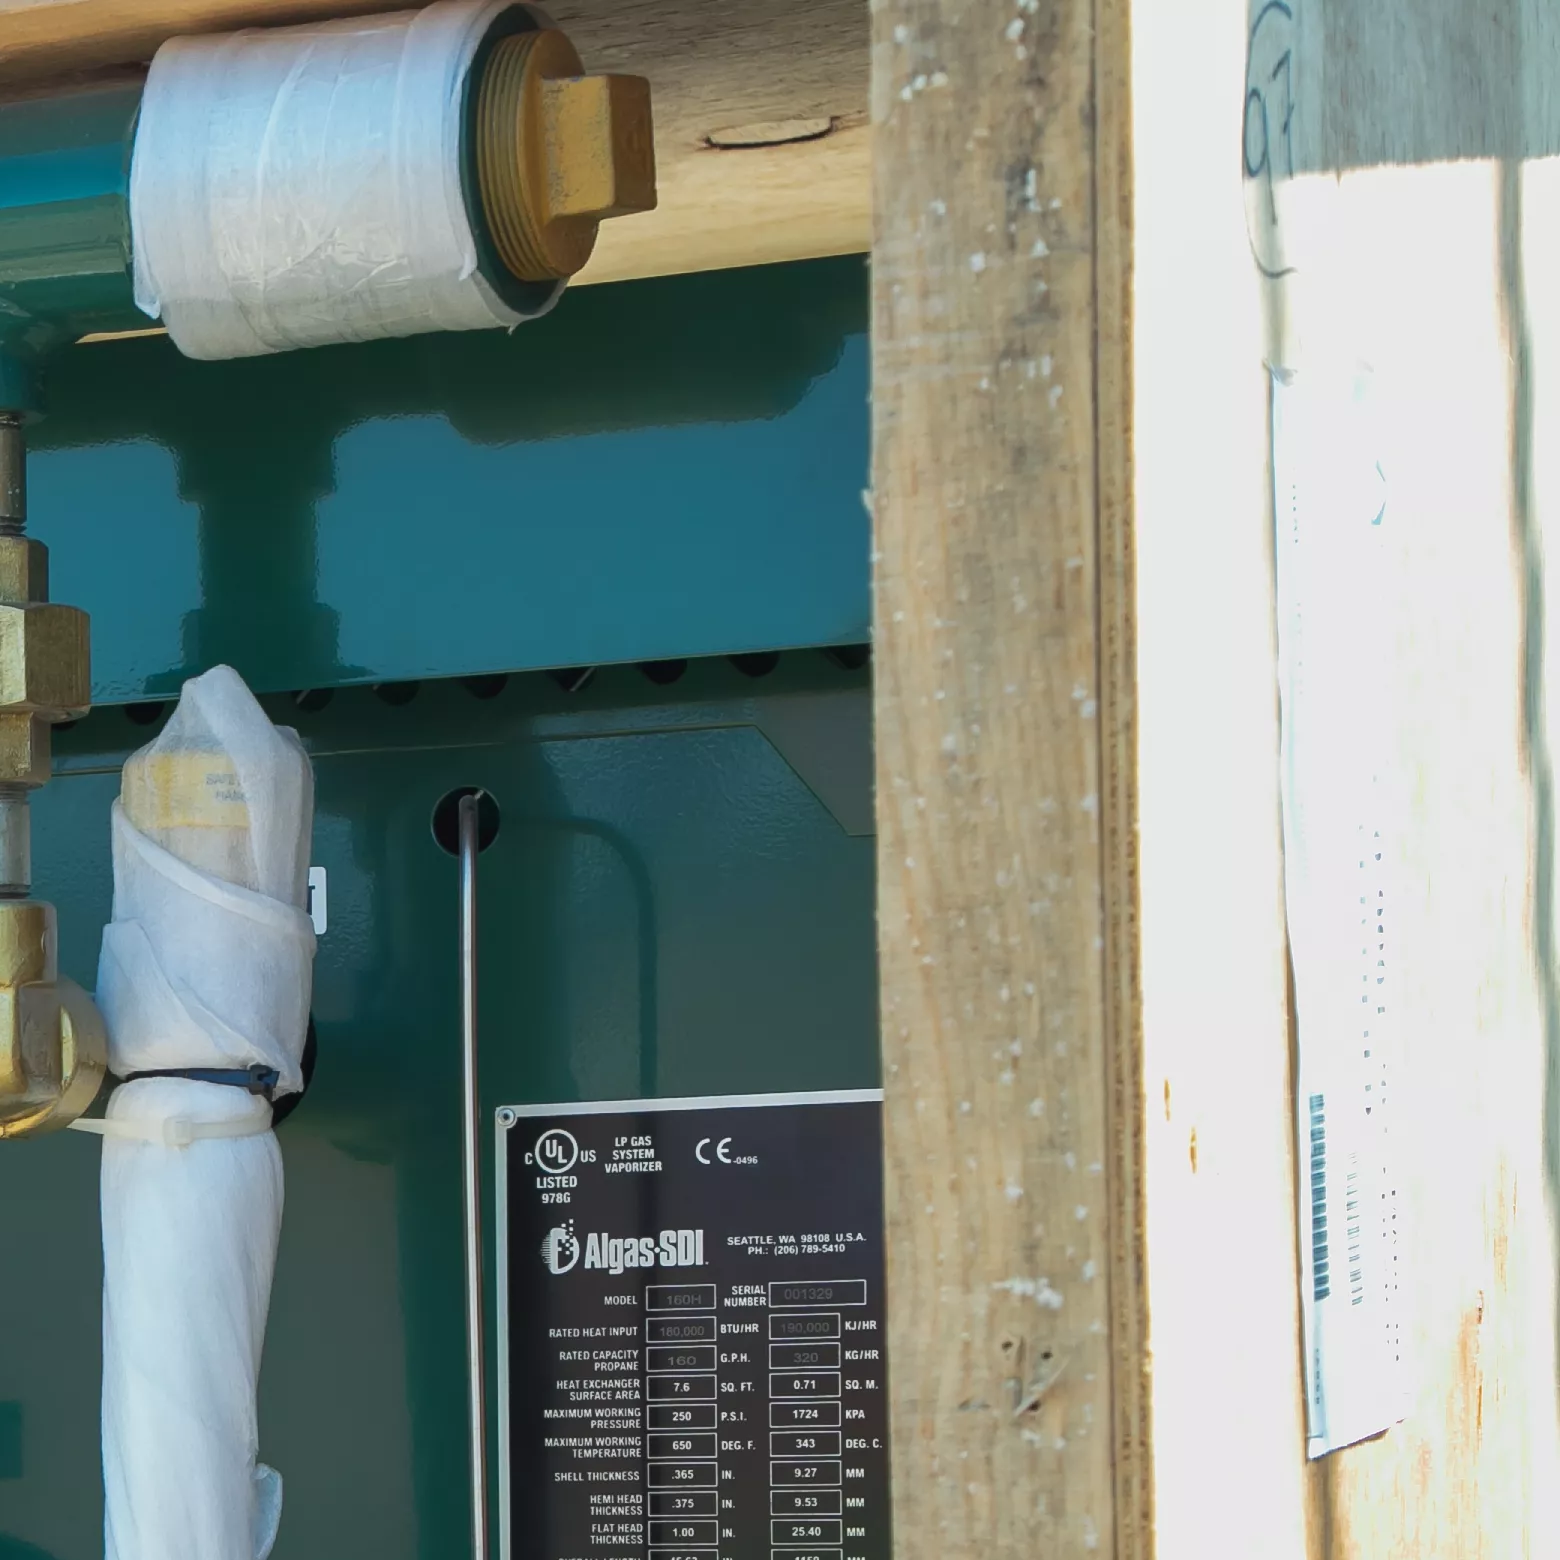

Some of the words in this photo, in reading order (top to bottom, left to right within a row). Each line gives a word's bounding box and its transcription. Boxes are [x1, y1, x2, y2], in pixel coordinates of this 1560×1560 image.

[615, 1136, 628, 1147] LP
[630, 1136, 652, 1146] GAS
[612, 1148, 654, 1160] SYSTEM
[604, 1161, 662, 1173] VAPORIZER
[536, 1176, 578, 1188] LISTED
[542, 1192, 571, 1204] 978G
[604, 1295, 637, 1305] MODEL
[549, 1328, 580, 1338] RATED
[582, 1327, 606, 1337] HEAT
[609, 1326, 638, 1336] INPUT
[720, 1323, 760, 1334] BTU/HR
[845, 1320, 877, 1330] KJ/HR
